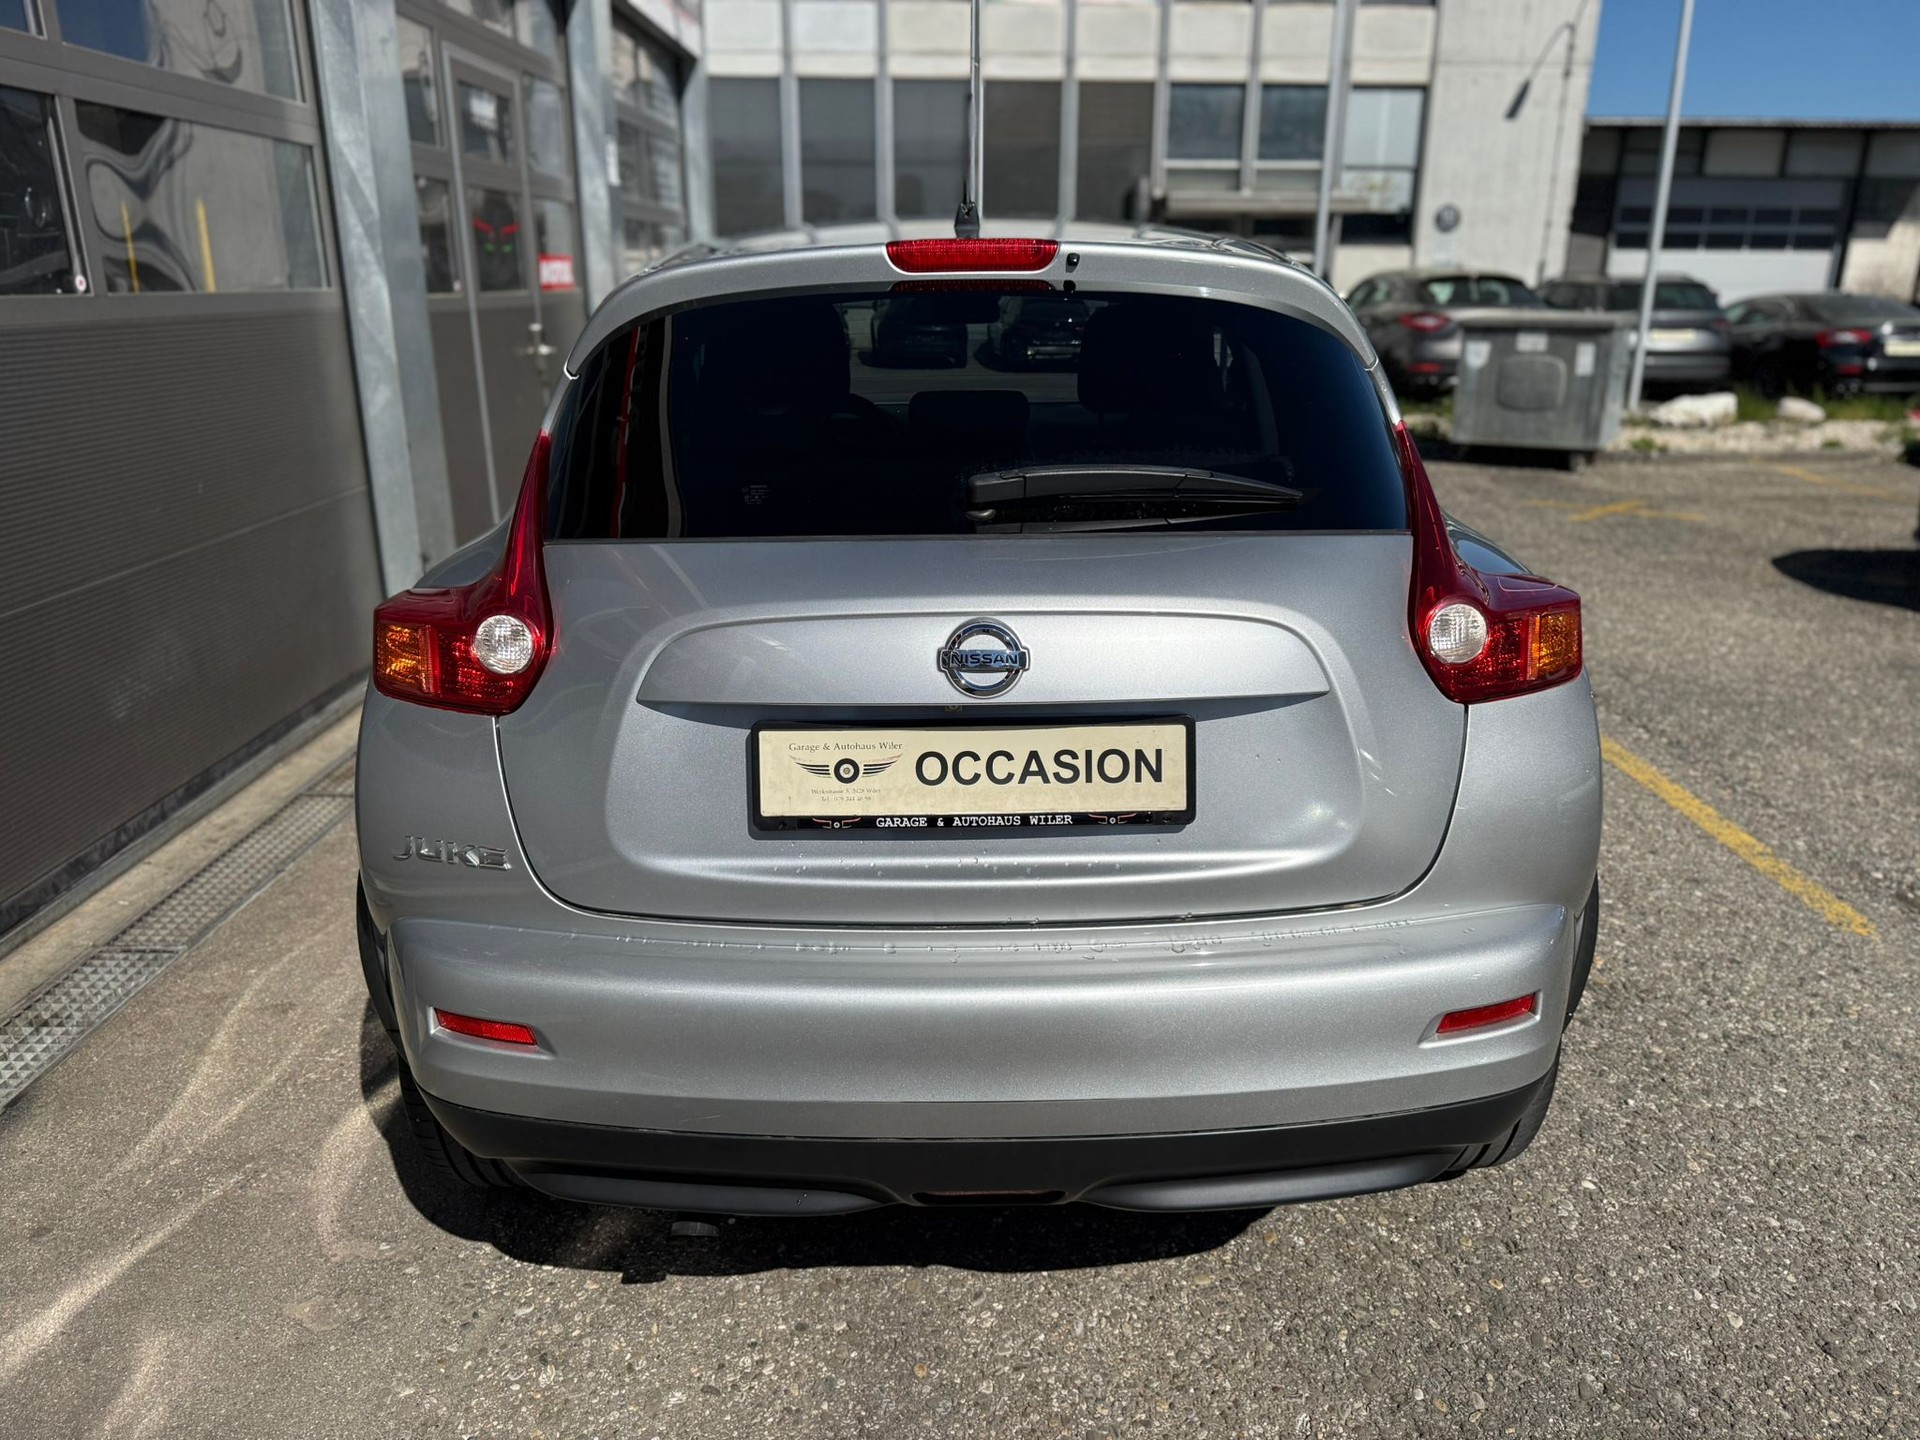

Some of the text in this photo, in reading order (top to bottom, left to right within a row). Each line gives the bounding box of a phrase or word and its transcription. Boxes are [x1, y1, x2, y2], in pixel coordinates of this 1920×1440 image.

[951, 653, 1018, 665] NISSAN
[788, 741, 903, 753] Garage & Autohaus Wiler
[915, 748, 1163, 786] OCCASION
[876, 814, 1073, 828] GARAGE & AUTOHAUS WILER
